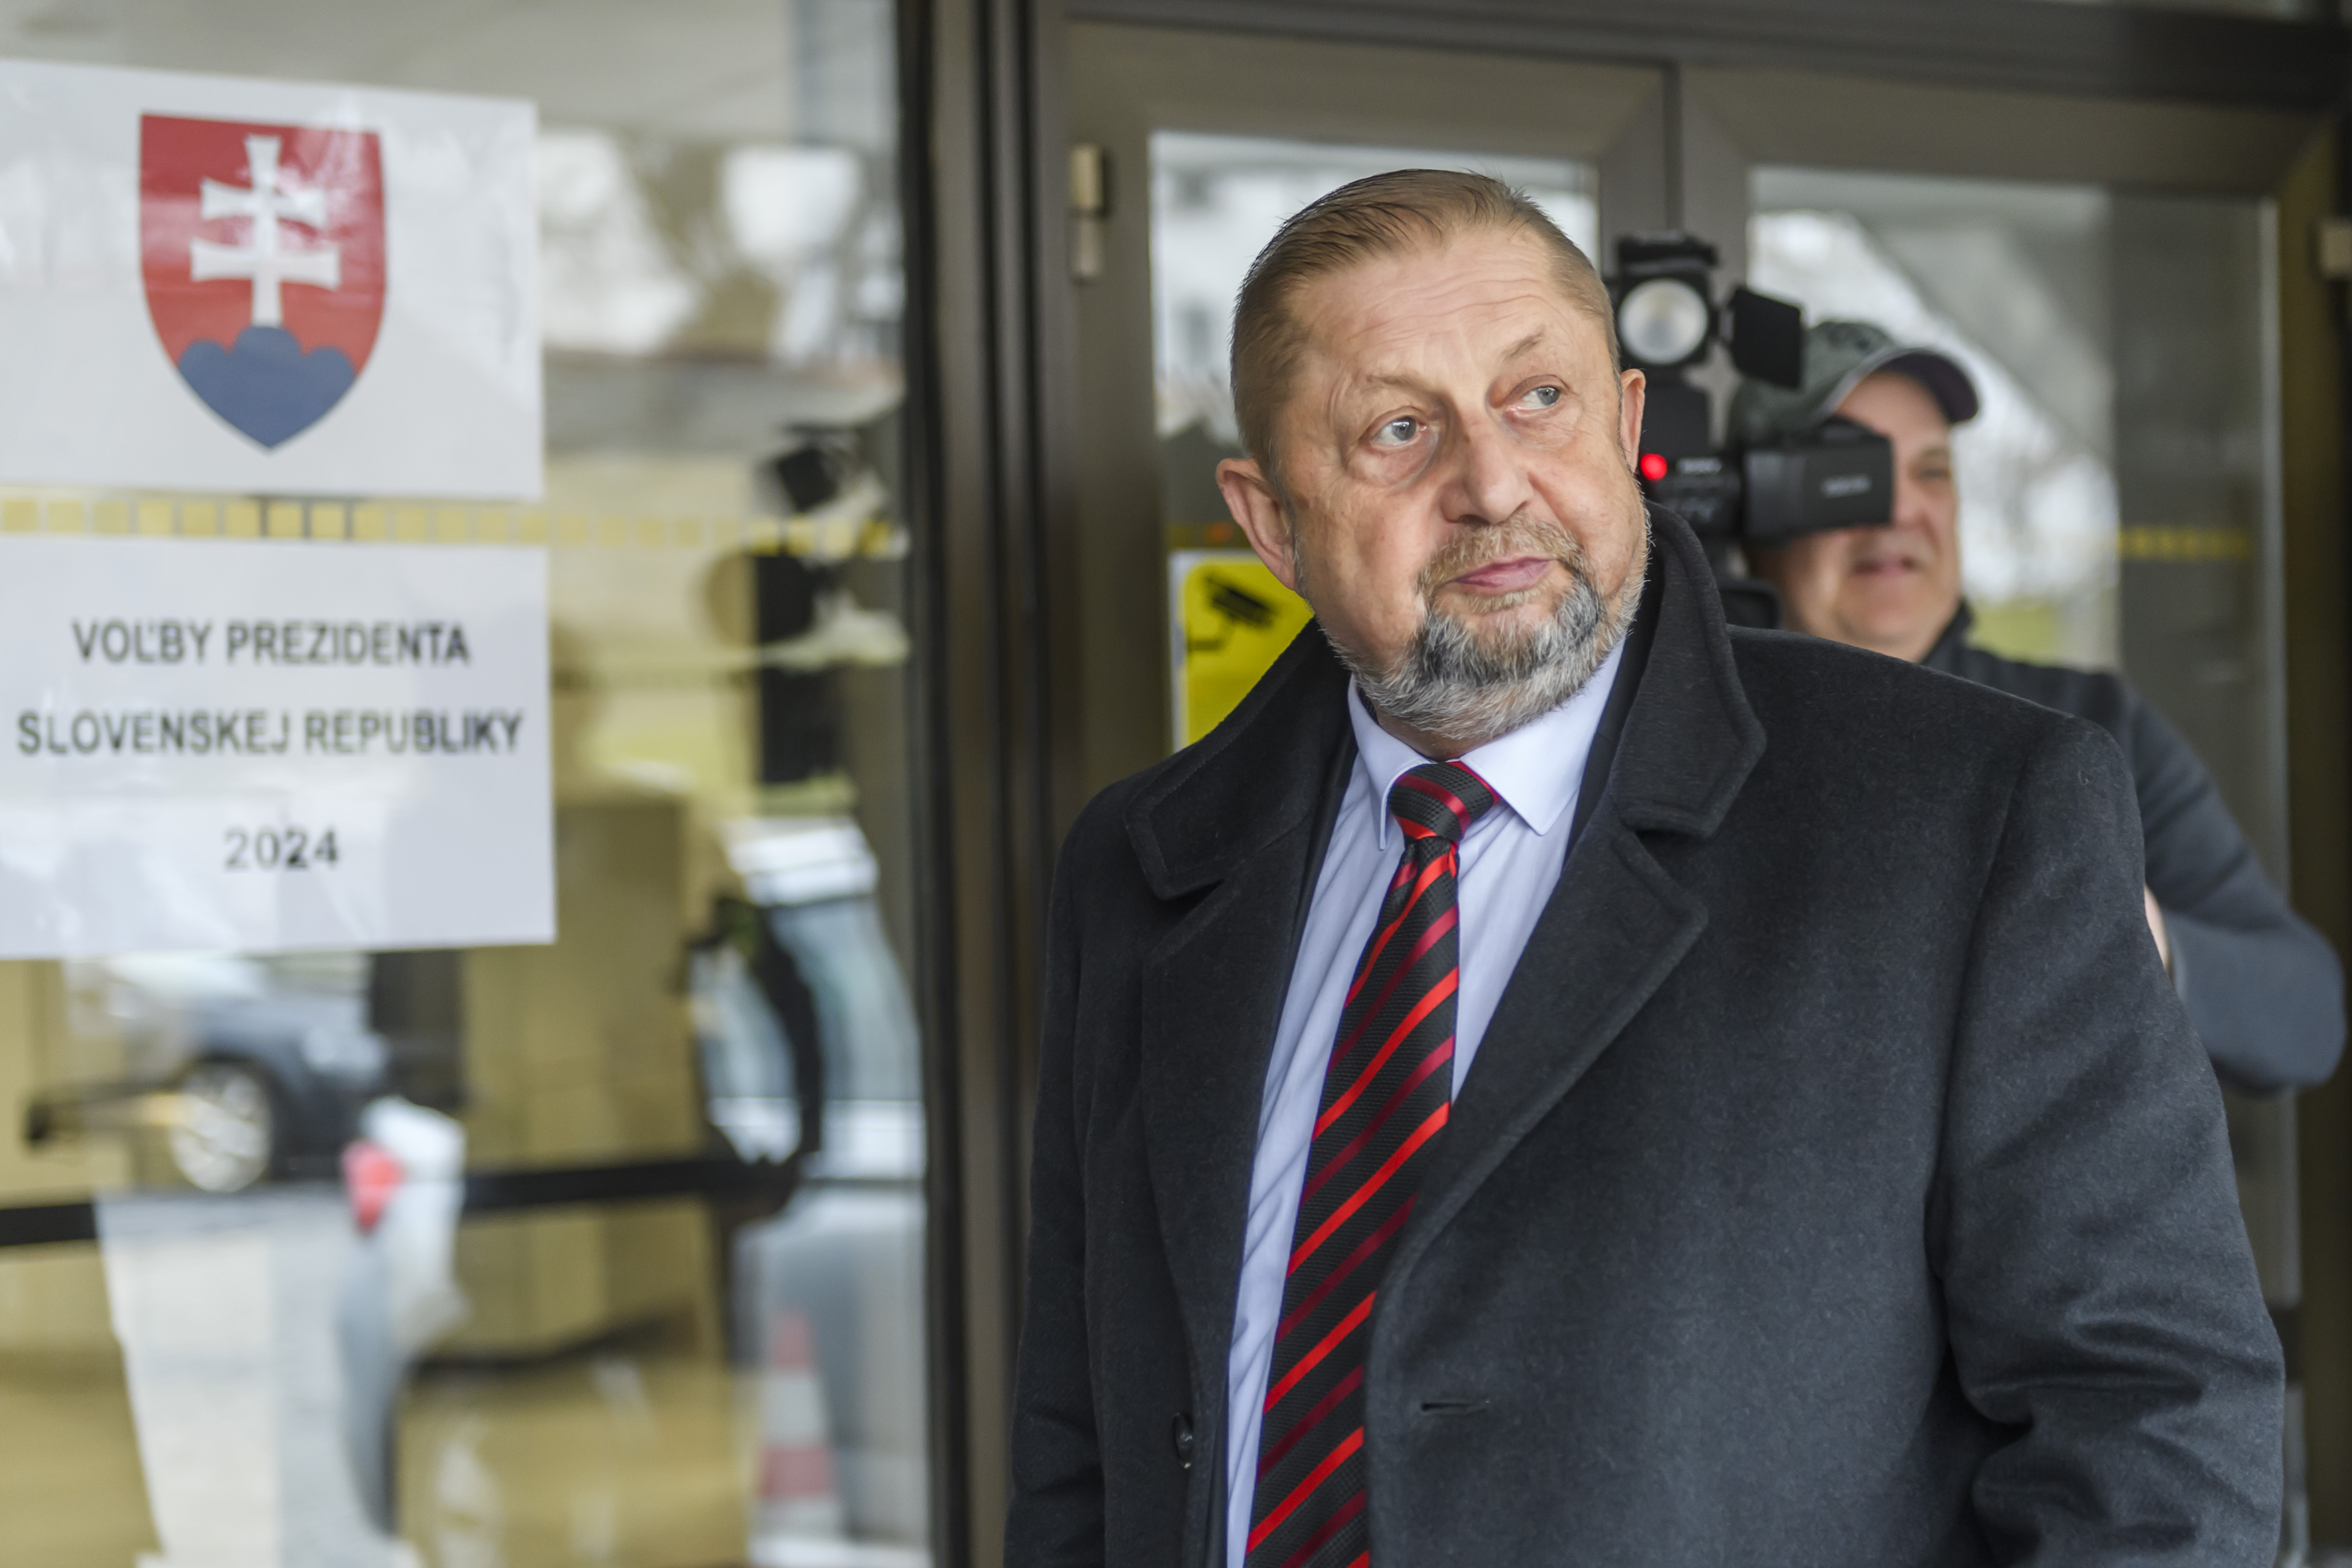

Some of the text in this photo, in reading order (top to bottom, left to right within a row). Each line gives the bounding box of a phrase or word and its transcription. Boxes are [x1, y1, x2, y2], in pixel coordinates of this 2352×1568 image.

[72, 620, 470, 664] VOĽBY PREZIDENTA
[18, 710, 521, 755] SLOVENSKEJ REPUBLIKY
[225, 827, 340, 870] 2024
